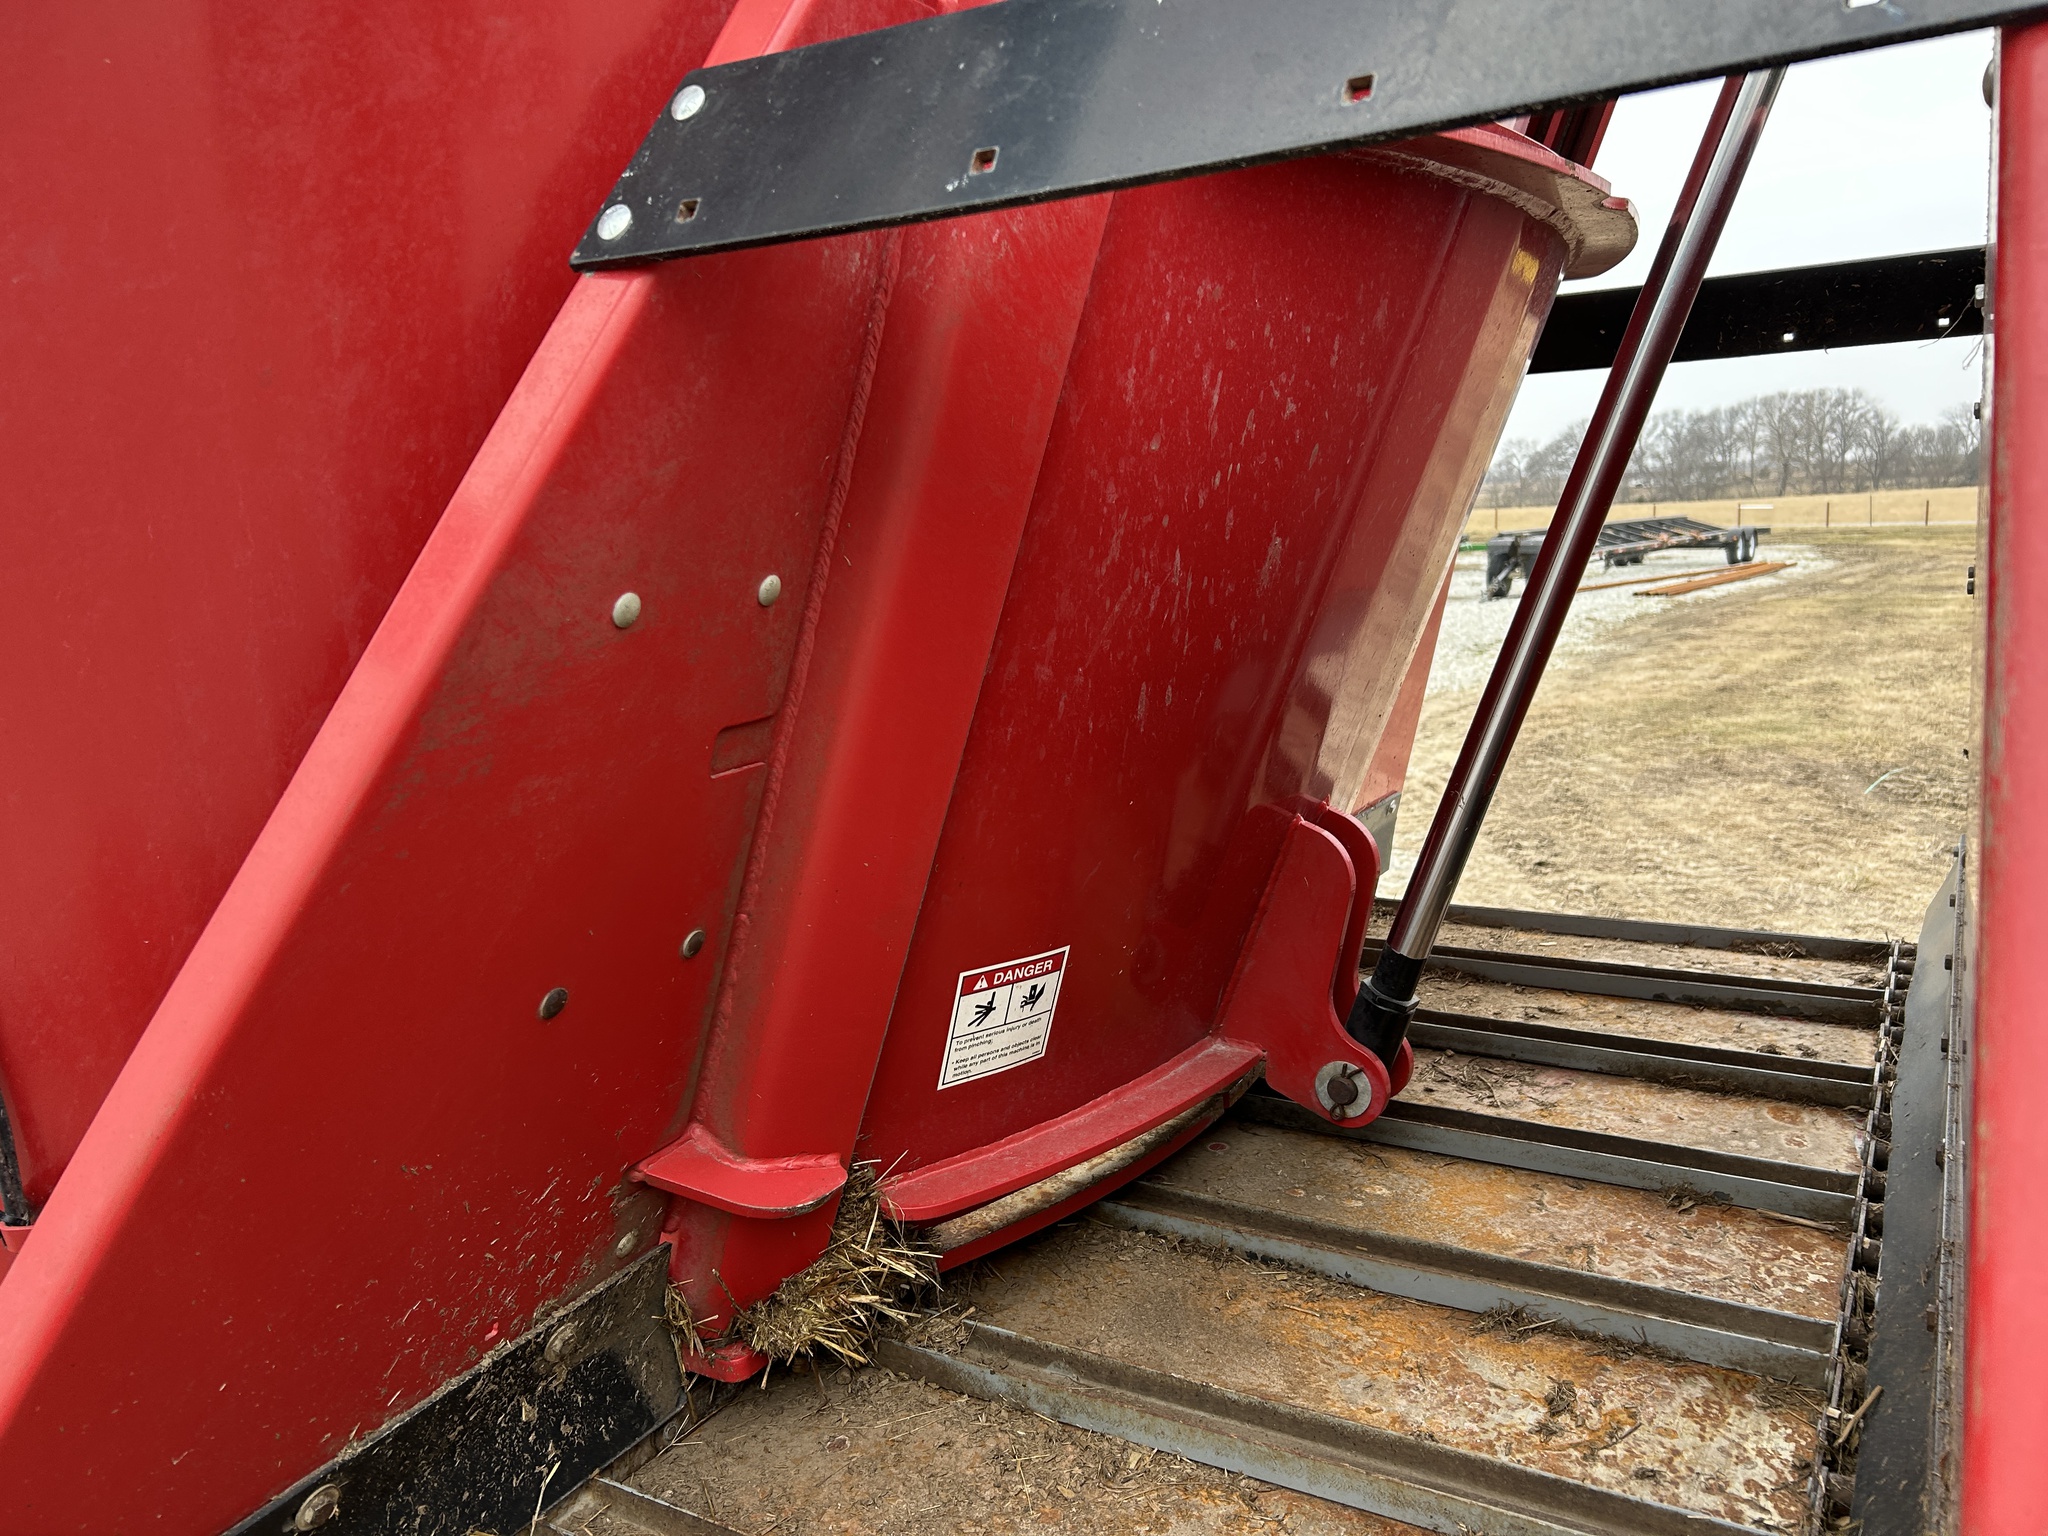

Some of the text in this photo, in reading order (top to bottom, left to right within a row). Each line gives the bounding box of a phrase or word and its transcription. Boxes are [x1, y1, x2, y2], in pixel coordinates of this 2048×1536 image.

[993, 960, 1053, 985] DANGER
[964, 1034, 984, 1045] prevent
[1006, 1024, 1021, 1032] injury
[954, 1063, 968, 1071] while
[980, 1056, 991, 1065] part
[1009, 1045, 1029, 1054] machine
[955, 1057, 969, 1066] Keep
[978, 1049, 999, 1060] persons
[1011, 1039, 1029, 1050] objects
